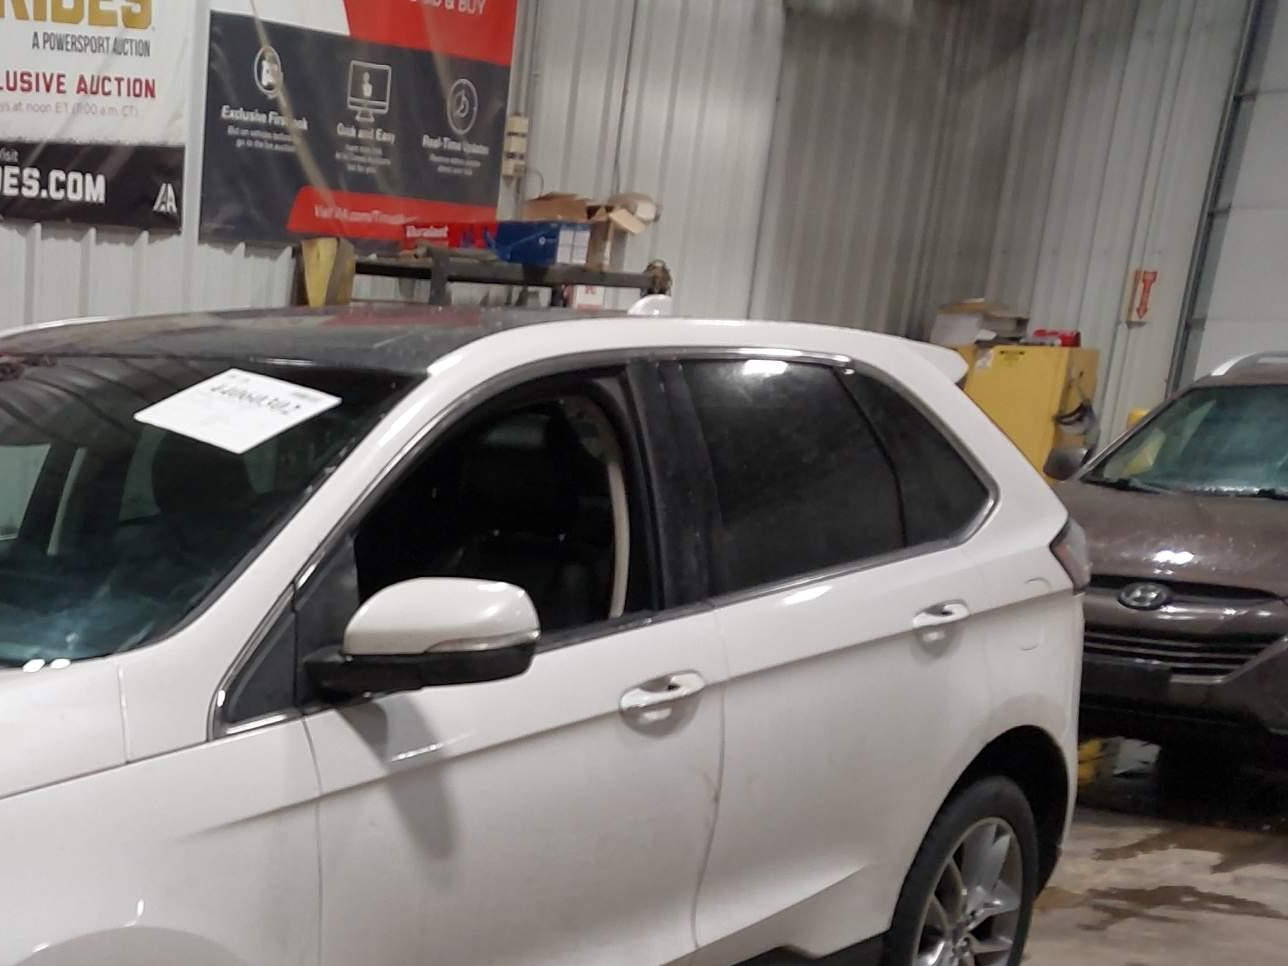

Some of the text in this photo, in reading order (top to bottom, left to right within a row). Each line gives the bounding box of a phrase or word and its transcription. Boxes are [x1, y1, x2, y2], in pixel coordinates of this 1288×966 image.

[32, 31, 150, 57] A POWERSPORT AUCTION
[76, 74, 156, 99] AUCTION
